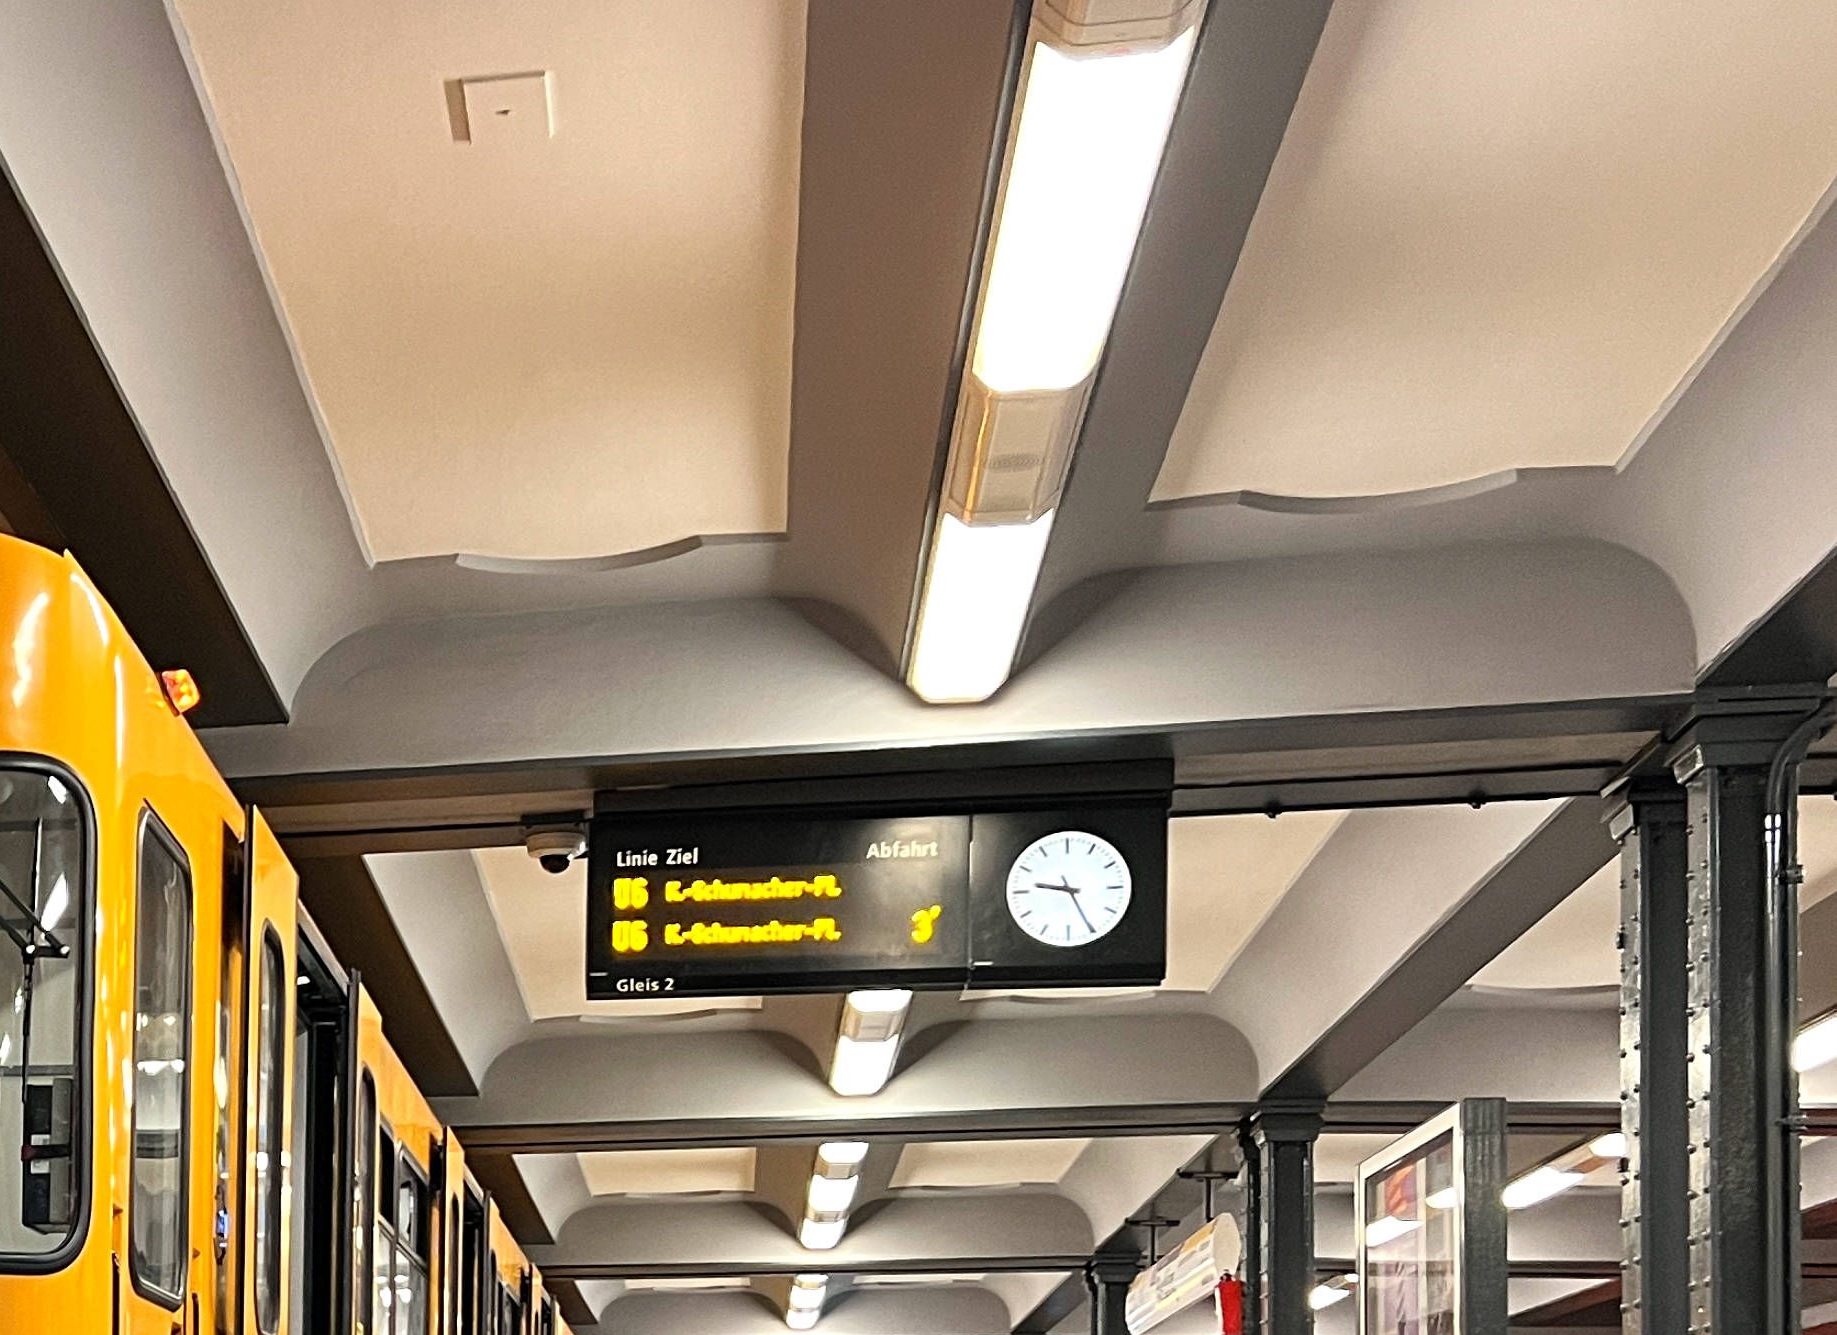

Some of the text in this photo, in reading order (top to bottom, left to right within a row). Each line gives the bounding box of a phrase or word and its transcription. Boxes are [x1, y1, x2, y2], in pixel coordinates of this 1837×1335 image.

[616, 841, 939, 867] Linie Ziel Abfahrt
[613, 877, 649, 910] U6
[612, 920, 649, 952] U6
[616, 977, 675, 992] Gleis 2
